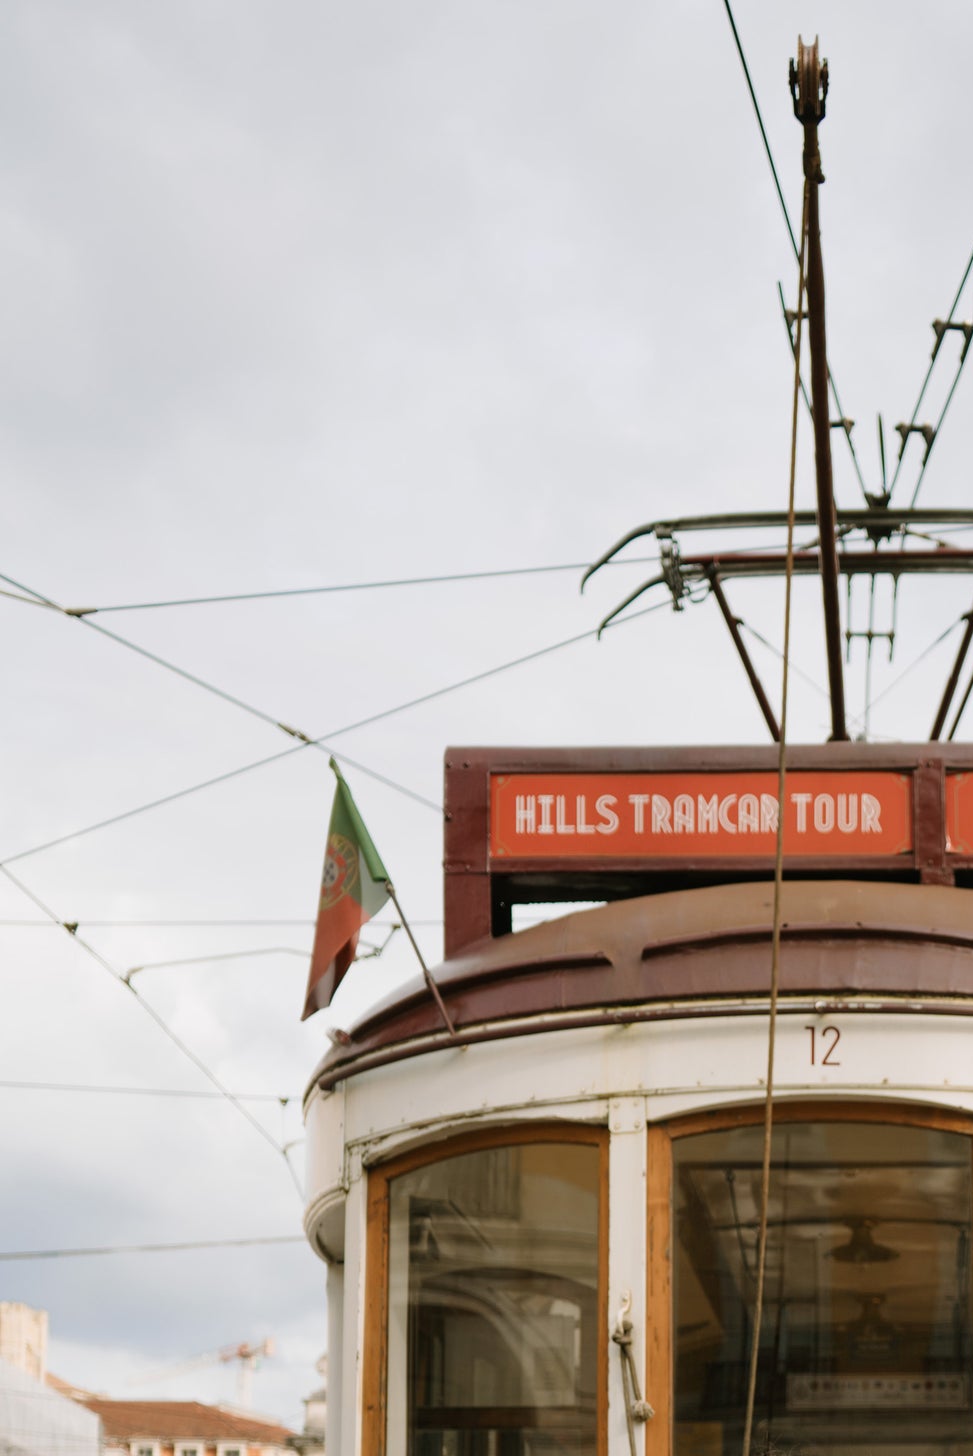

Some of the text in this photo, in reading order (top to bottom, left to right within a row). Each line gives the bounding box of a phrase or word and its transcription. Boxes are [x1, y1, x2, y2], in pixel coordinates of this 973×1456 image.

[515, 793, 883, 835] HILLS TRAMCAR TOUR
[805, 1025, 841, 1066] 12
